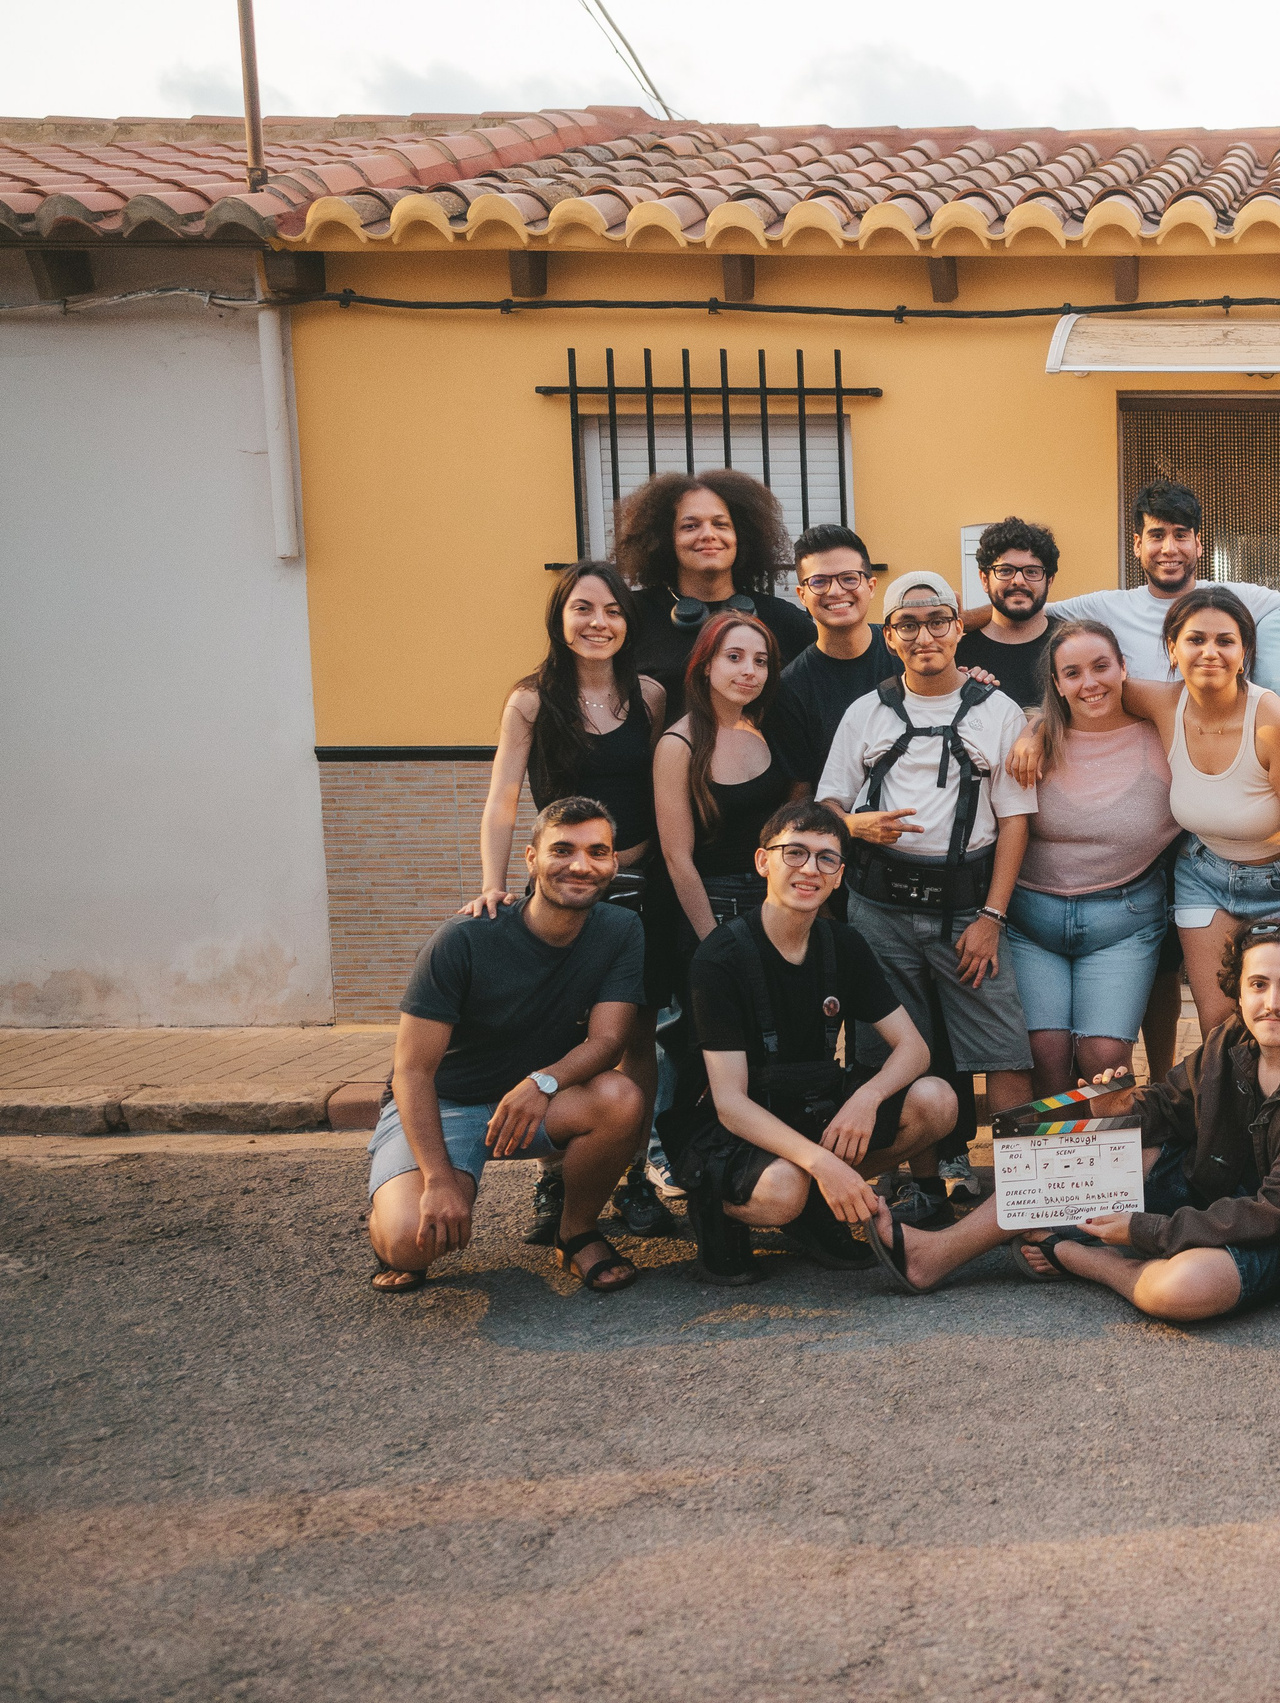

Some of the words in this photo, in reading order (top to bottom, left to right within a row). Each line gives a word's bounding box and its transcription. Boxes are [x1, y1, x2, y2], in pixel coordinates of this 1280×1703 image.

[1030, 1138, 1049, 1148] NOT
[1047, 1181, 1066, 1191] PERE
[1044, 1195, 1080, 1205] BRANDON
